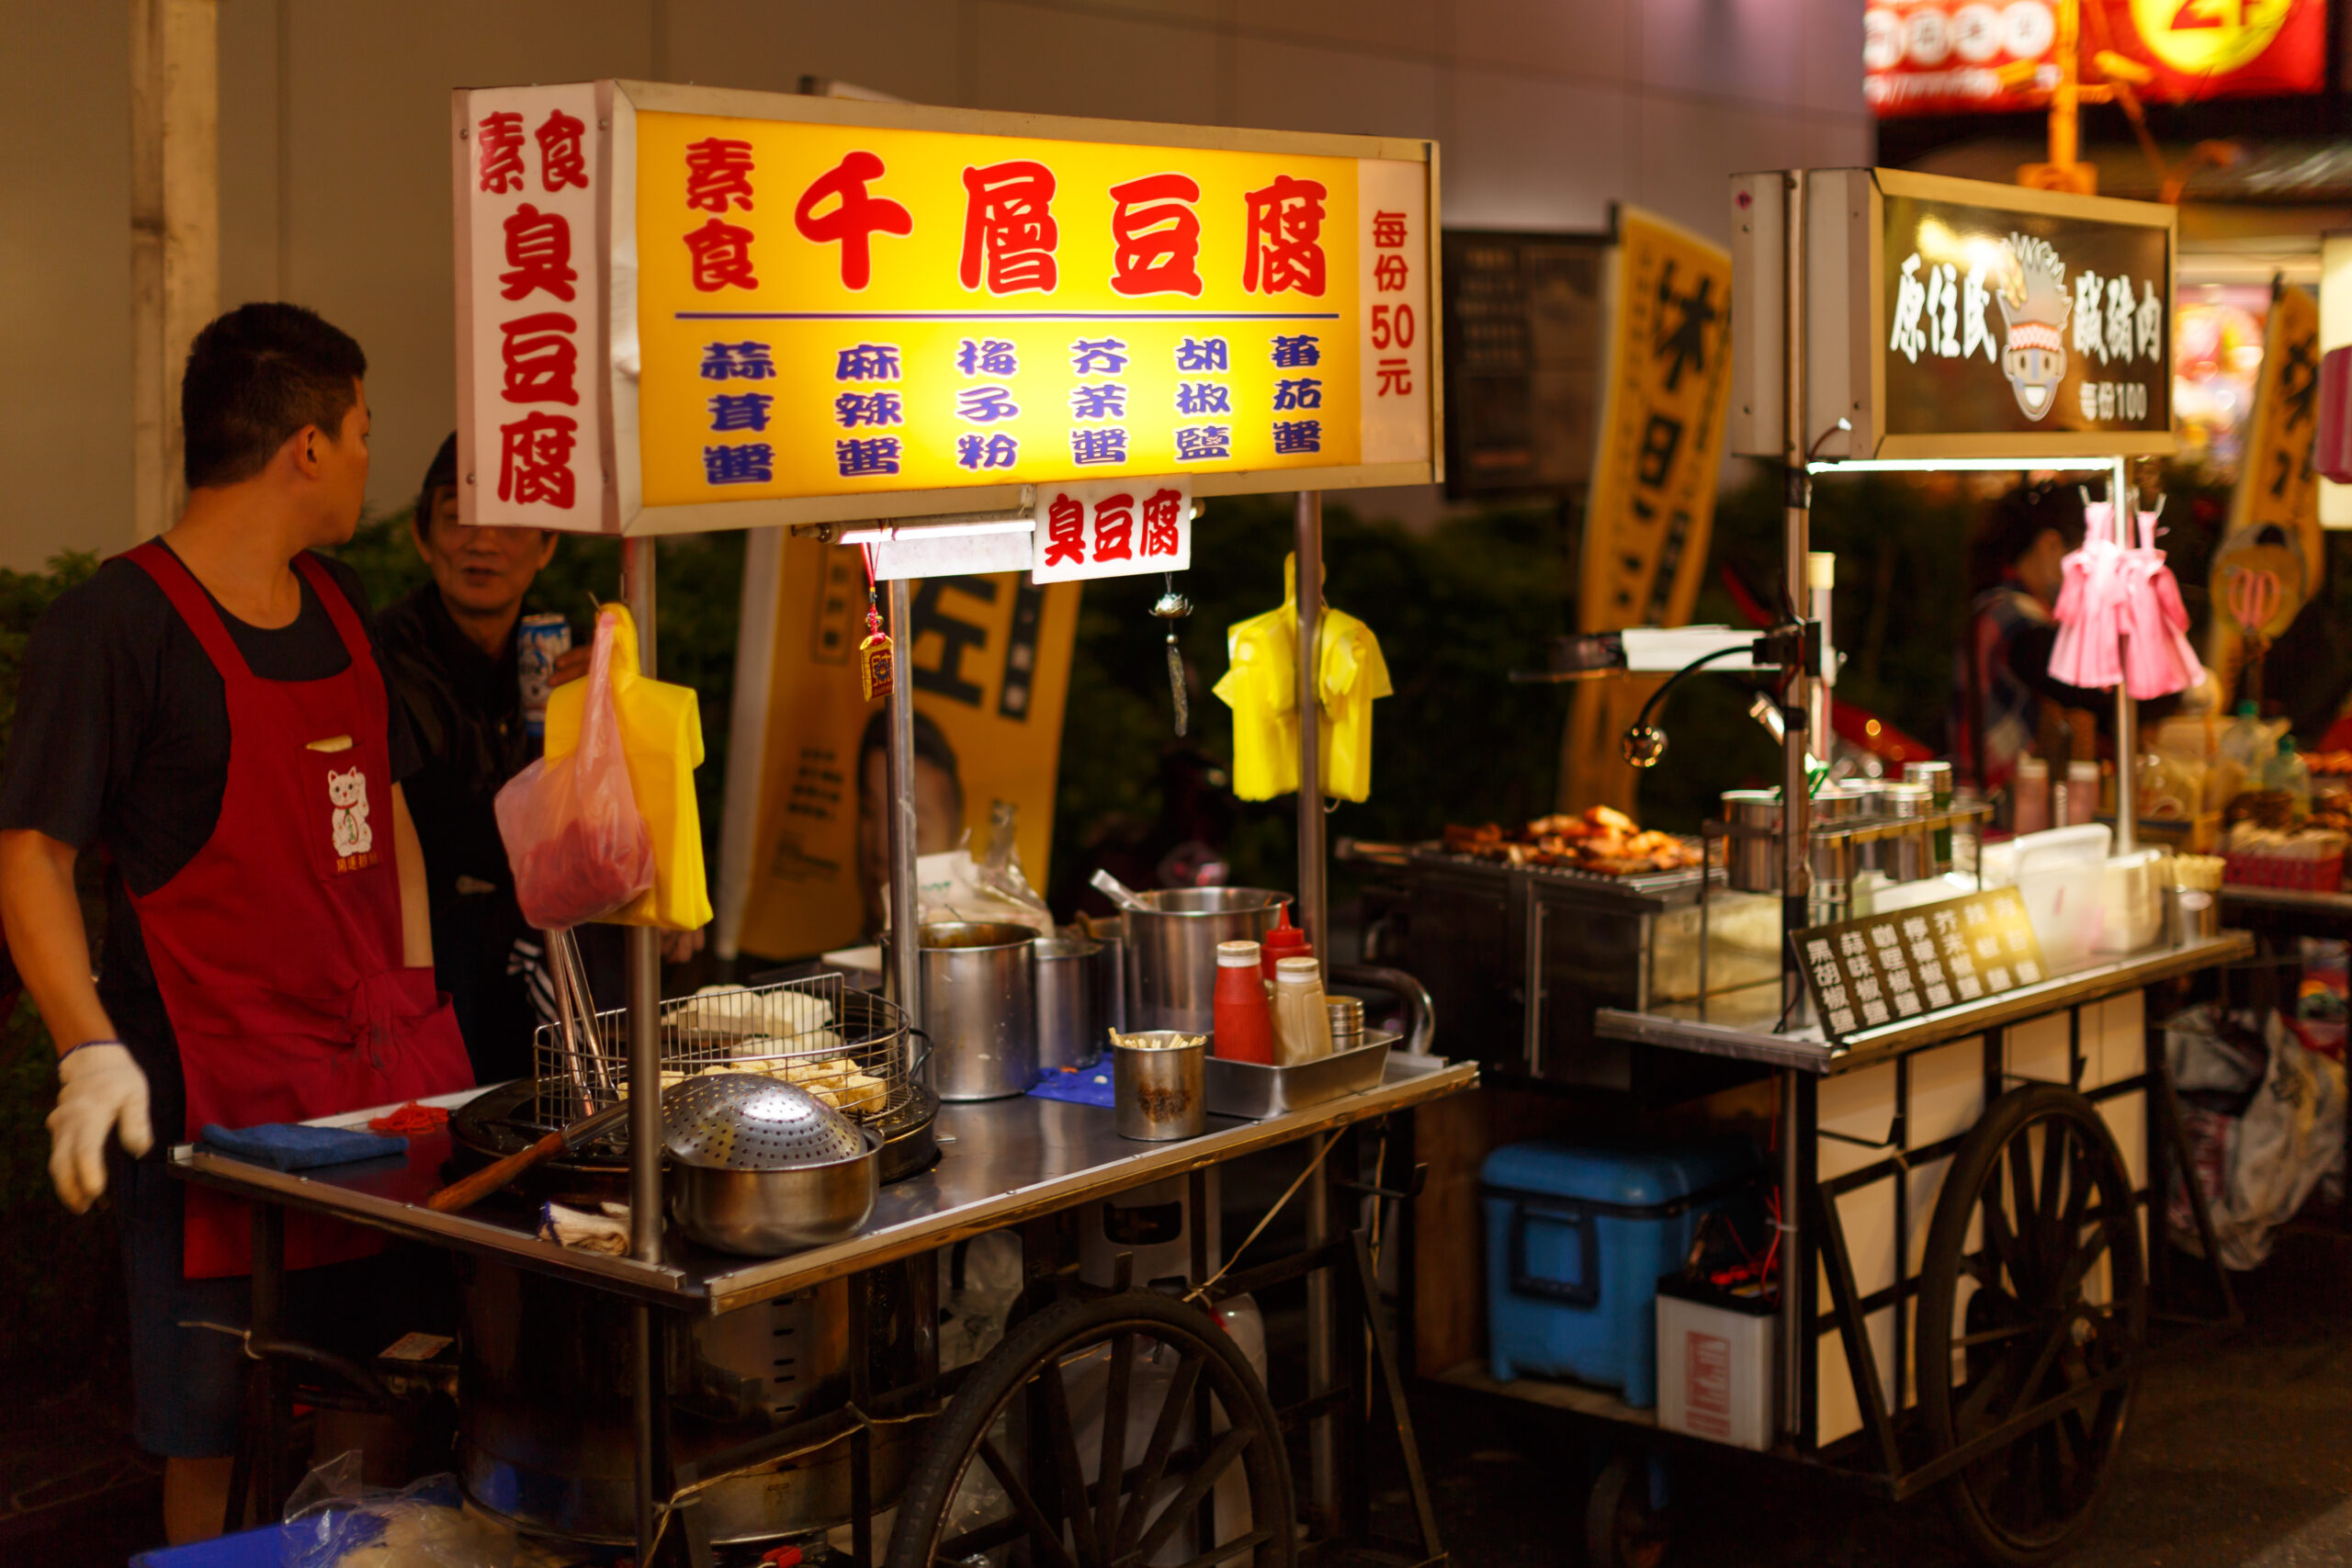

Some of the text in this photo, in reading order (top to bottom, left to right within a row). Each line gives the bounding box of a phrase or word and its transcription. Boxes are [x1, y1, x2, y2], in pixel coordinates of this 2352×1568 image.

[478, 109, 589, 195] 素食
[683, 137, 759, 292] 素食
[794, 151, 1328, 297] 千層豆腐
[498, 203, 581, 510] 臭豆腐
[1372, 210, 1414, 397] 每份50元
[1890, 253, 1997, 365] 原住民
[700, 341, 776, 485] 蒜茸醬
[835, 344, 903, 476] 麻辣醬
[956, 340, 1020, 469] 梅子粉
[1175, 338, 1231, 460] 胡椒鹽
[1271, 335, 1323, 454] 蕃茄醬
[1045, 488, 1182, 567] 臭豆腐
